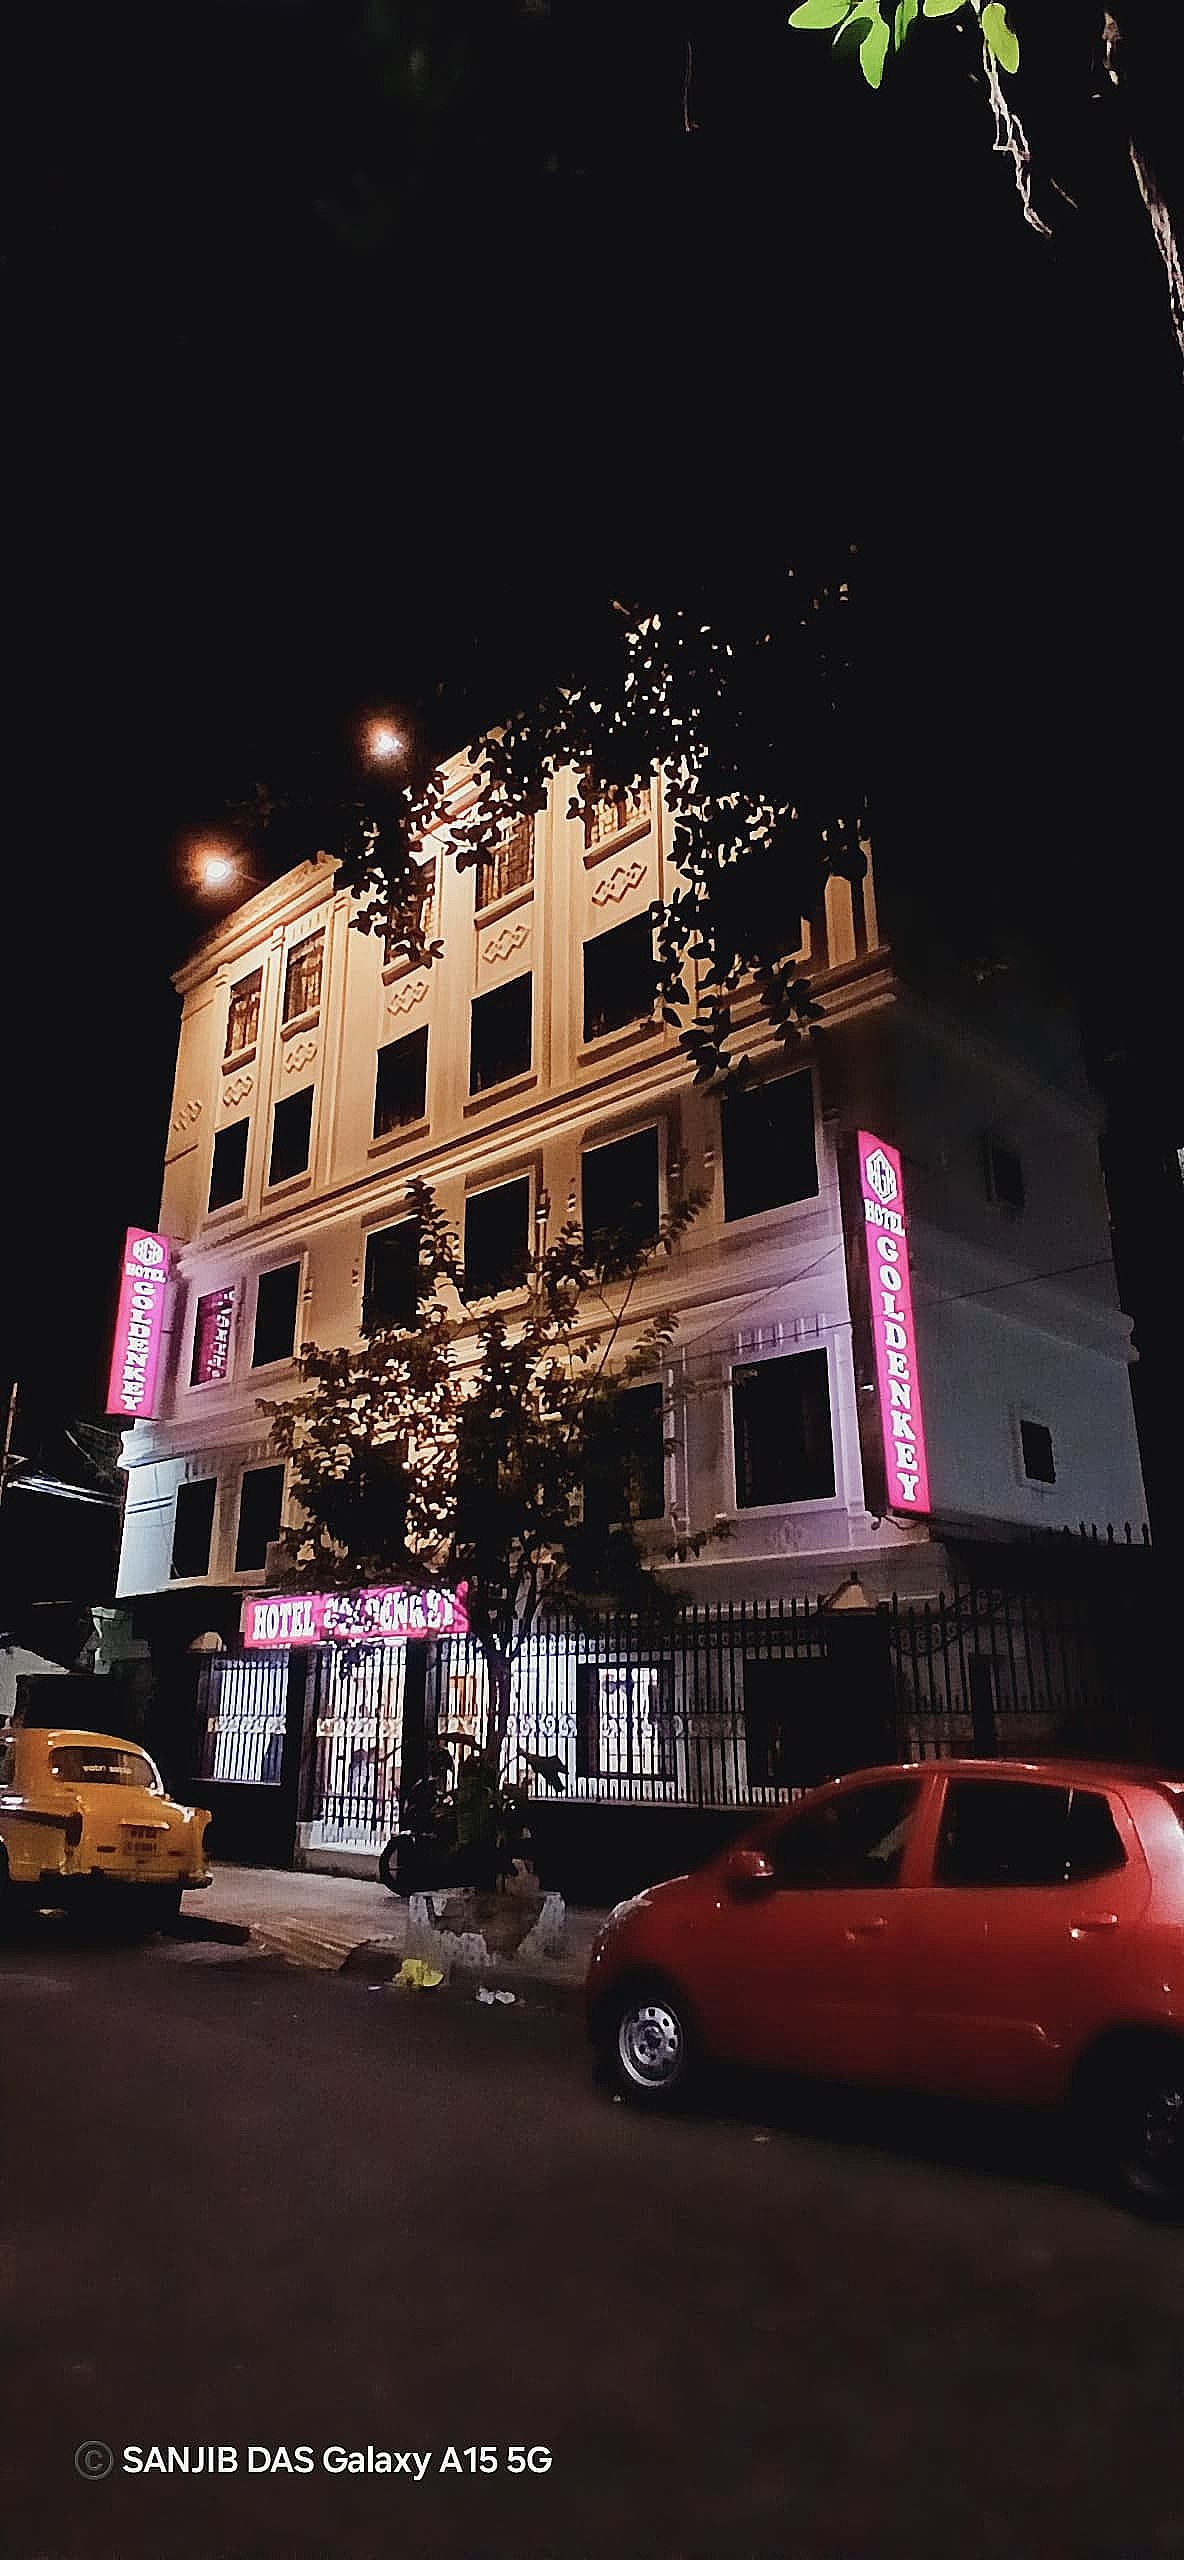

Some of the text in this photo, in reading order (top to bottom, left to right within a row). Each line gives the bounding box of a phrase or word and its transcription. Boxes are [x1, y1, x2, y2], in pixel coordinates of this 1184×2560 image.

[864, 1198, 906, 1237] HOTEL
[125, 1263, 166, 1283] HOTEL
[120, 1281, 155, 1411] GOLDENKEY
[876, 1235, 918, 1502] GOLDENKEY
[252, 1600, 315, 1640] HOTEL
